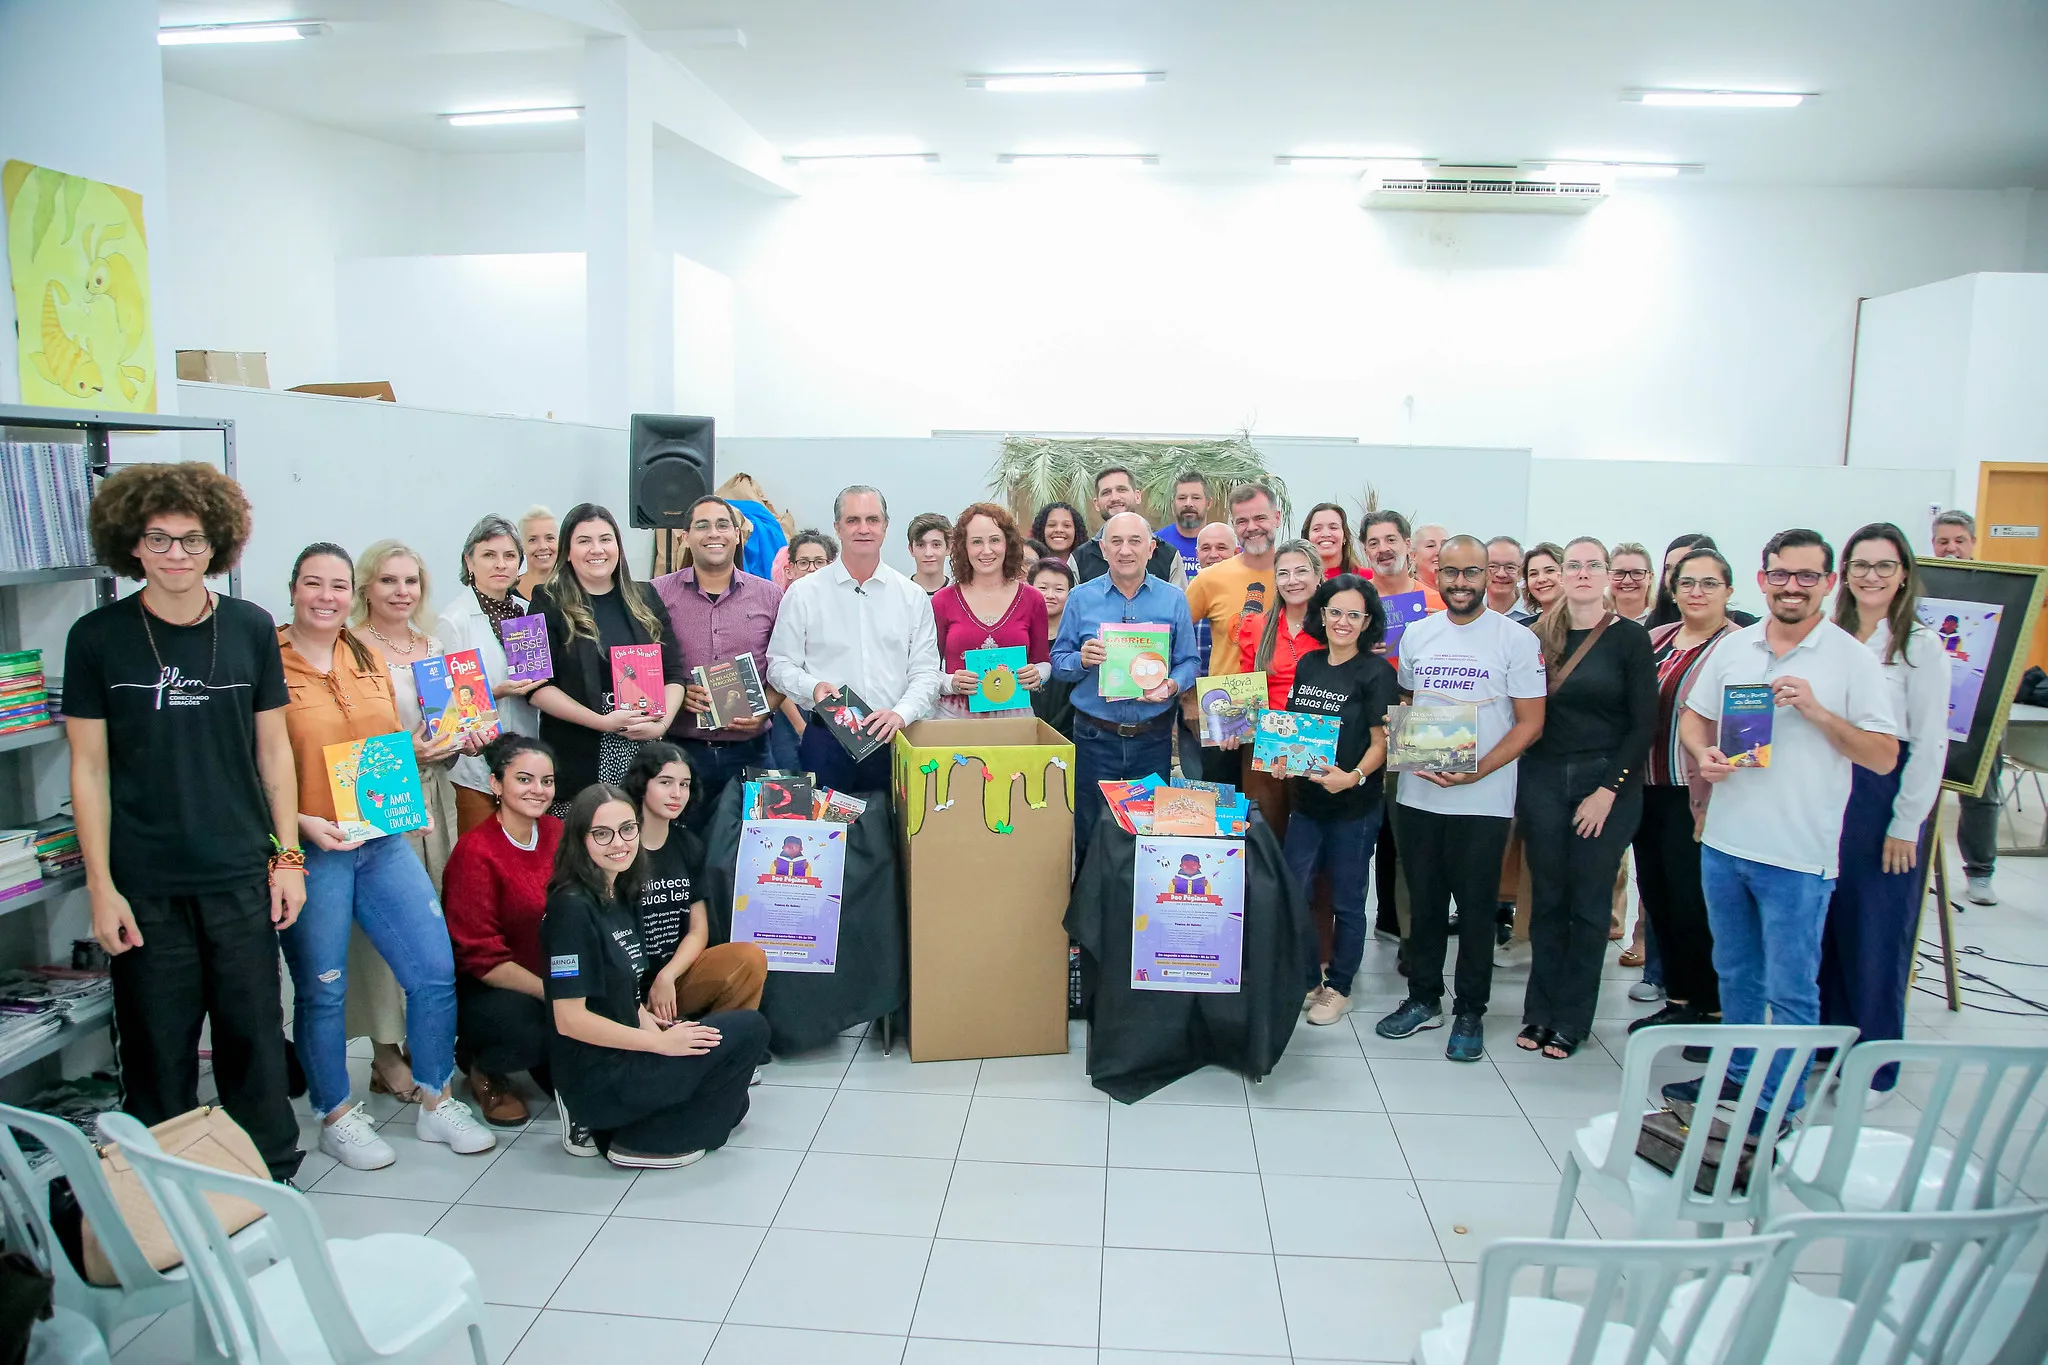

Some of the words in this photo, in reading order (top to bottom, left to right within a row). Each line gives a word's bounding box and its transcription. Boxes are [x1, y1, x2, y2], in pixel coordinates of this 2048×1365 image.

[523, 627, 544, 639] ELA
[511, 637, 546, 653] DISSE,
[627, 647, 636, 655] de
[526, 647, 547, 661] ELE
[450, 656, 477, 675] Ápis
[517, 658, 548, 674] DISSE
[1415, 666, 1490, 680] #LGBTIFOBIA
[1423, 679, 1431, 688] É
[1433, 679, 1475, 690] CRIME!
[1299, 697, 1322, 709] suas
[1322, 700, 1341, 712] leis
[389, 792, 415, 806] AMOR,
[384, 805, 410, 819] CUIDADO
[389, 812, 422, 830] EDUCAÇÃO
[642, 893, 668, 906] suas
[670, 889, 690, 902] leis
